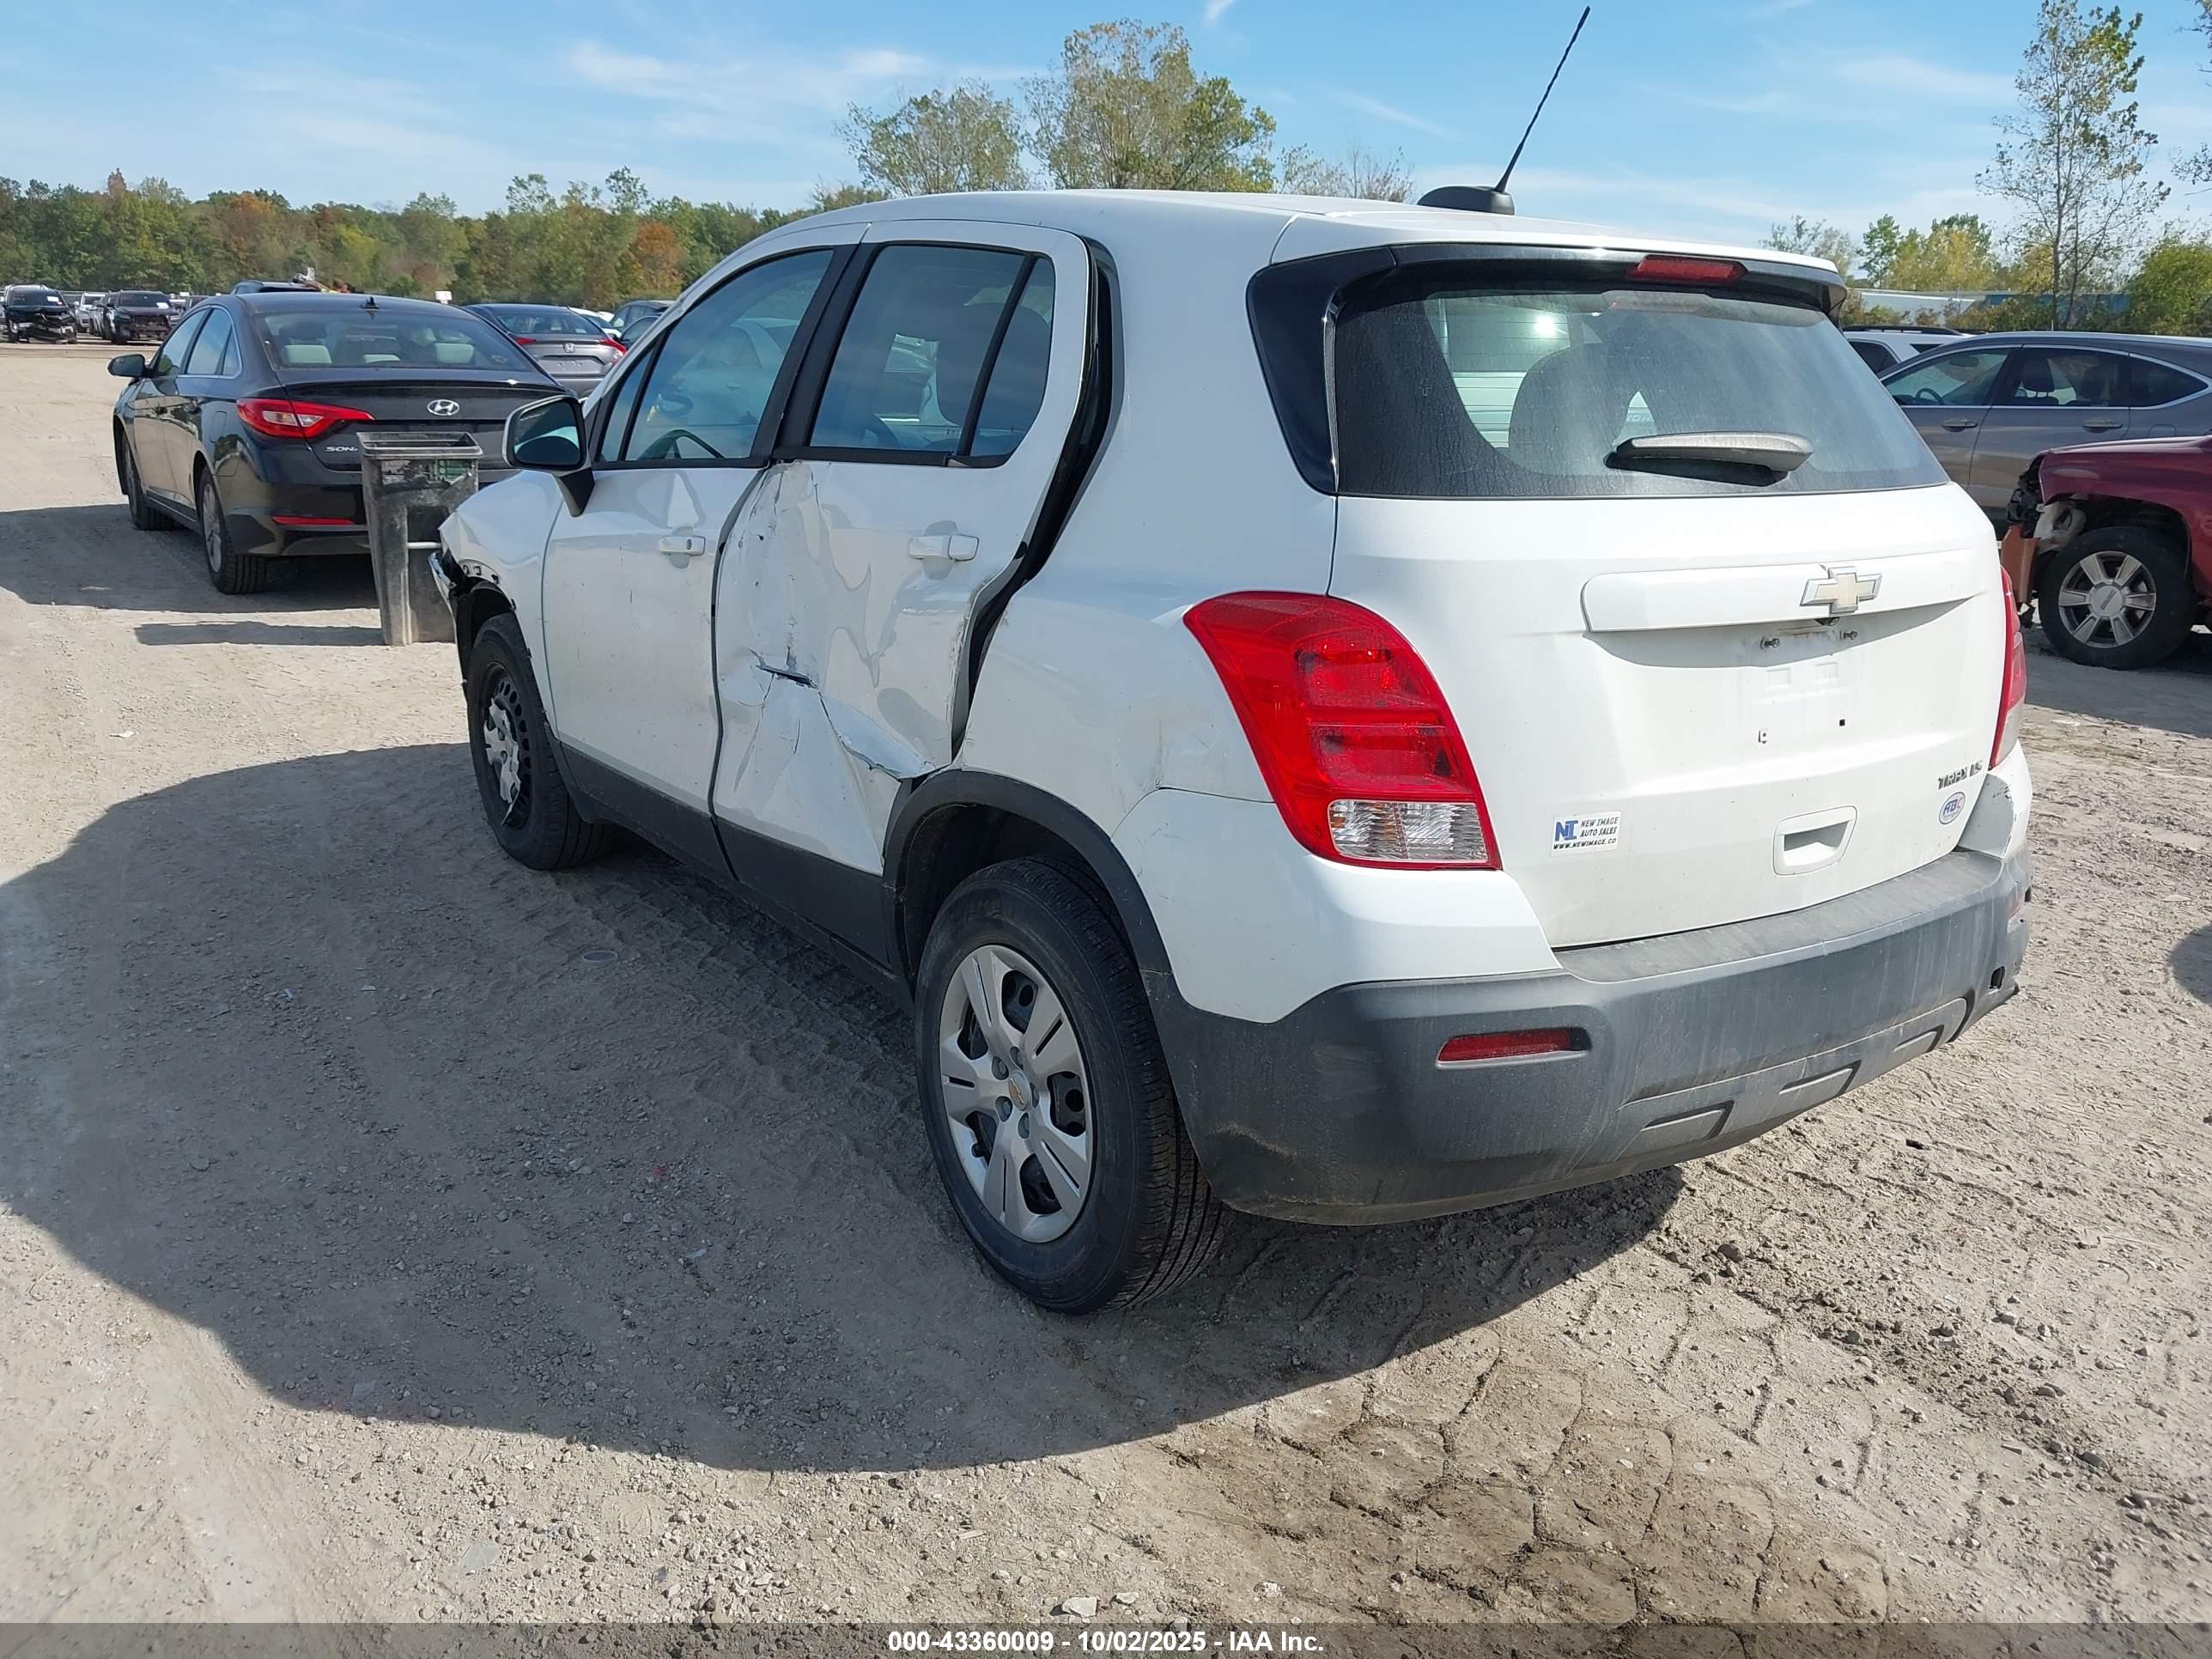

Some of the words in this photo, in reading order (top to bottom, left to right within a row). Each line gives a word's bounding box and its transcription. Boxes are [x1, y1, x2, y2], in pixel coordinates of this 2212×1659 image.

[1580, 818, 1596, 828] NEW
[1597, 817, 1620, 826] IMAGE
[1580, 829, 1598, 838] AUTO
[1598, 826, 1618, 836] SALES
